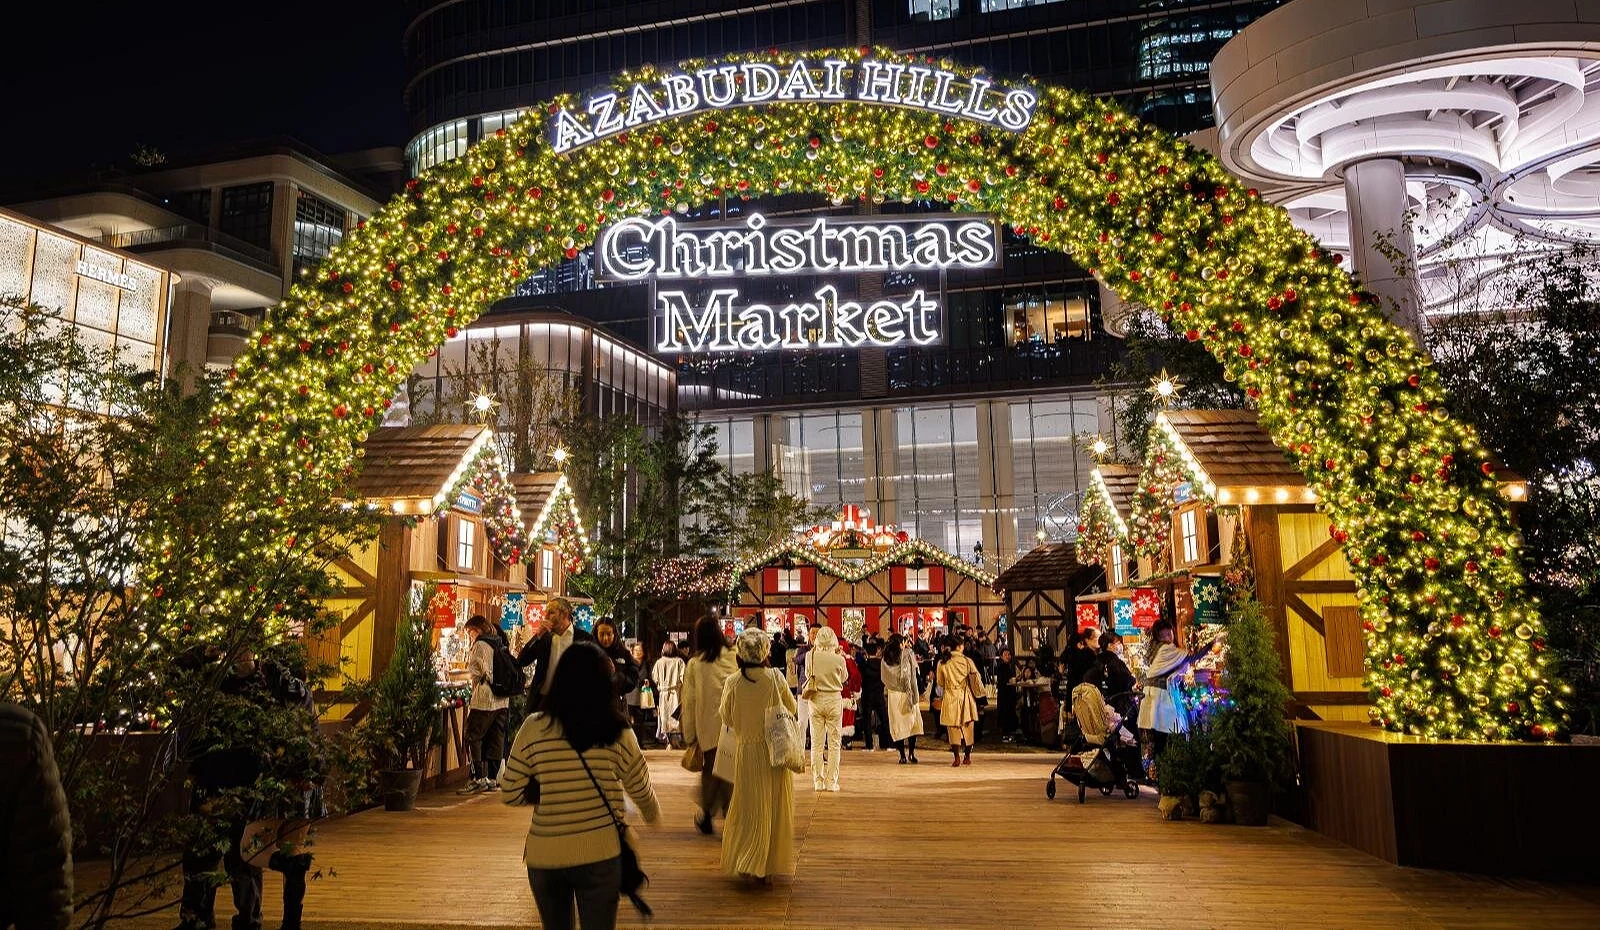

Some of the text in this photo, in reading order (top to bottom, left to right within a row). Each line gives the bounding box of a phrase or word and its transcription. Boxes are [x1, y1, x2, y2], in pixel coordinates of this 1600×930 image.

[553, 60, 1037, 153] AZABUDAI HILLS
[601, 213, 996, 280] Christmas
[657, 285, 940, 353] Market
